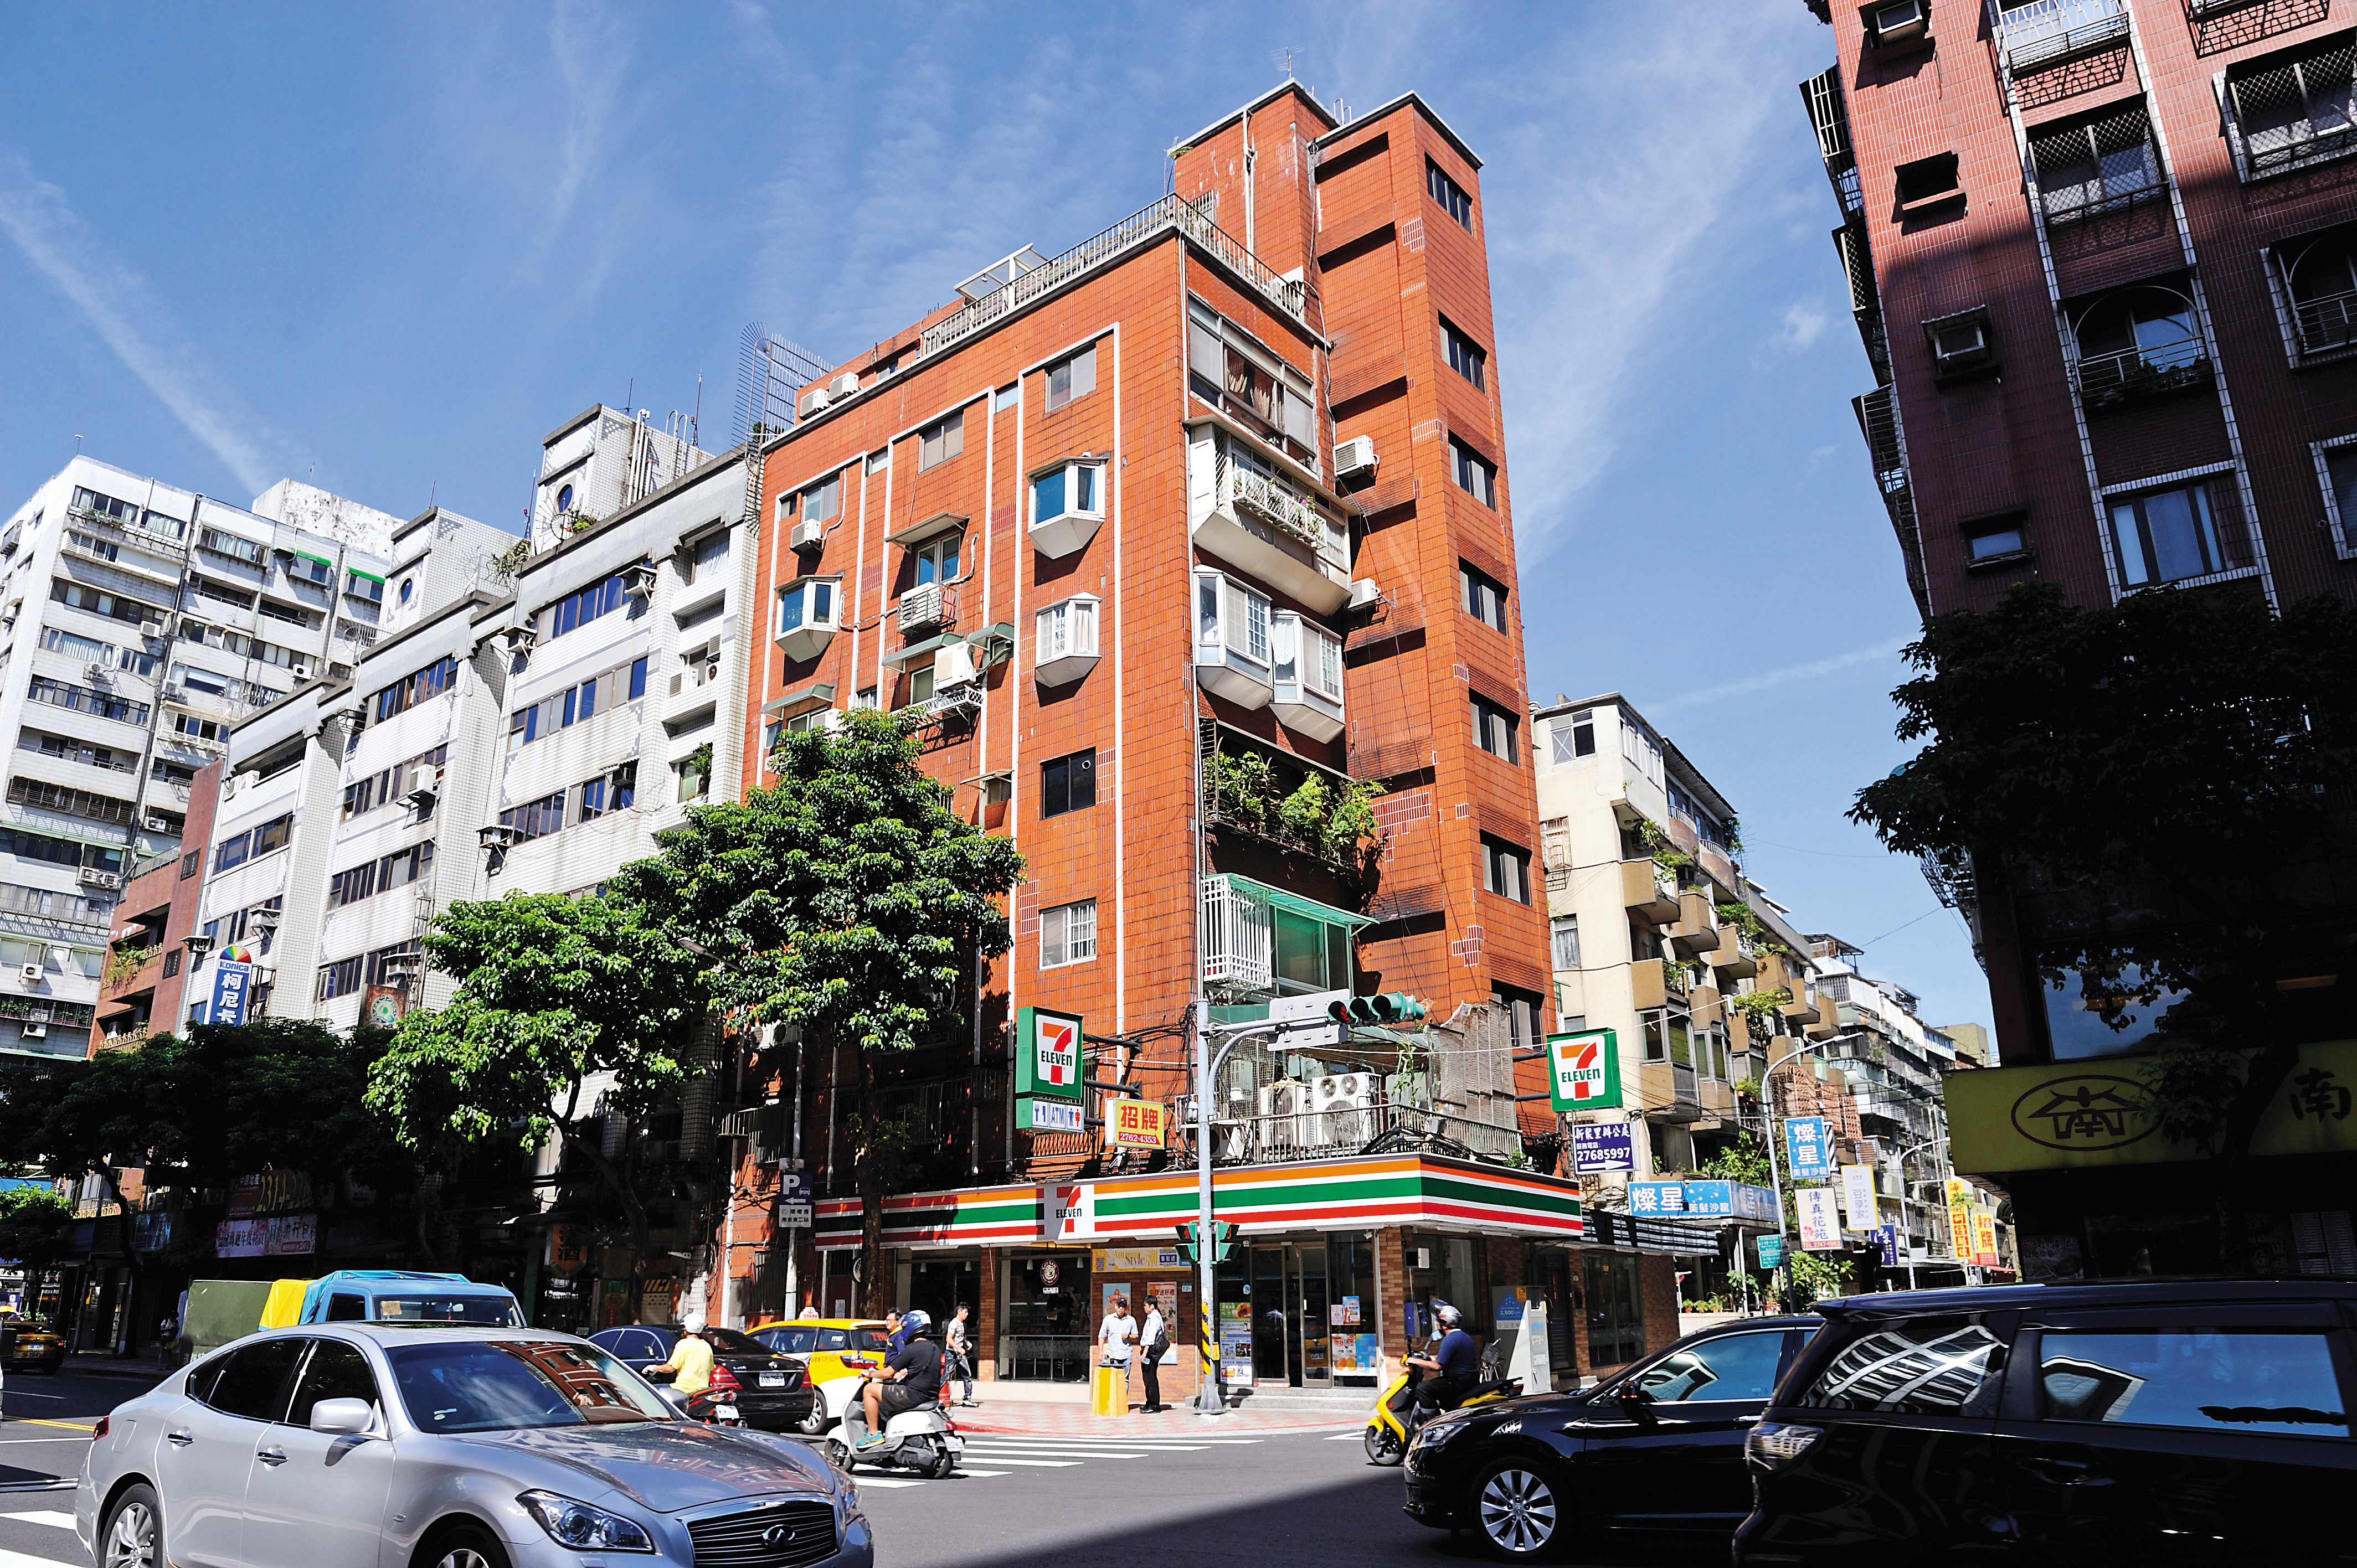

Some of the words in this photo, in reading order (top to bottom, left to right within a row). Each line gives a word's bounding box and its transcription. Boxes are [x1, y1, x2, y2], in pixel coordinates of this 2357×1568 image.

[219, 960, 249, 972] Konica
[217, 972, 244, 1024] 柯尼卡
[1041, 1050, 1073, 1067] ELEVEN
[1561, 1068, 1601, 1082] ELEVEN
[2289, 1067, 2351, 1122] 南
[1051, 1106, 1064, 1125] ATM
[1120, 1105, 1159, 1131] 招牌
[1119, 1132, 1157, 1144] 2762-4353
[1793, 1123, 1820, 1165] 燦星
[1577, 1147, 1631, 1162] 27685997
[783, 1174, 800, 1195] P
[1632, 1187, 1684, 1213] 燦星
[1056, 1208, 1082, 1219] ELEVEN
[1808, 1191, 1829, 1240] 傳真花苑
[1978, 1215, 1993, 1252] 招牌
